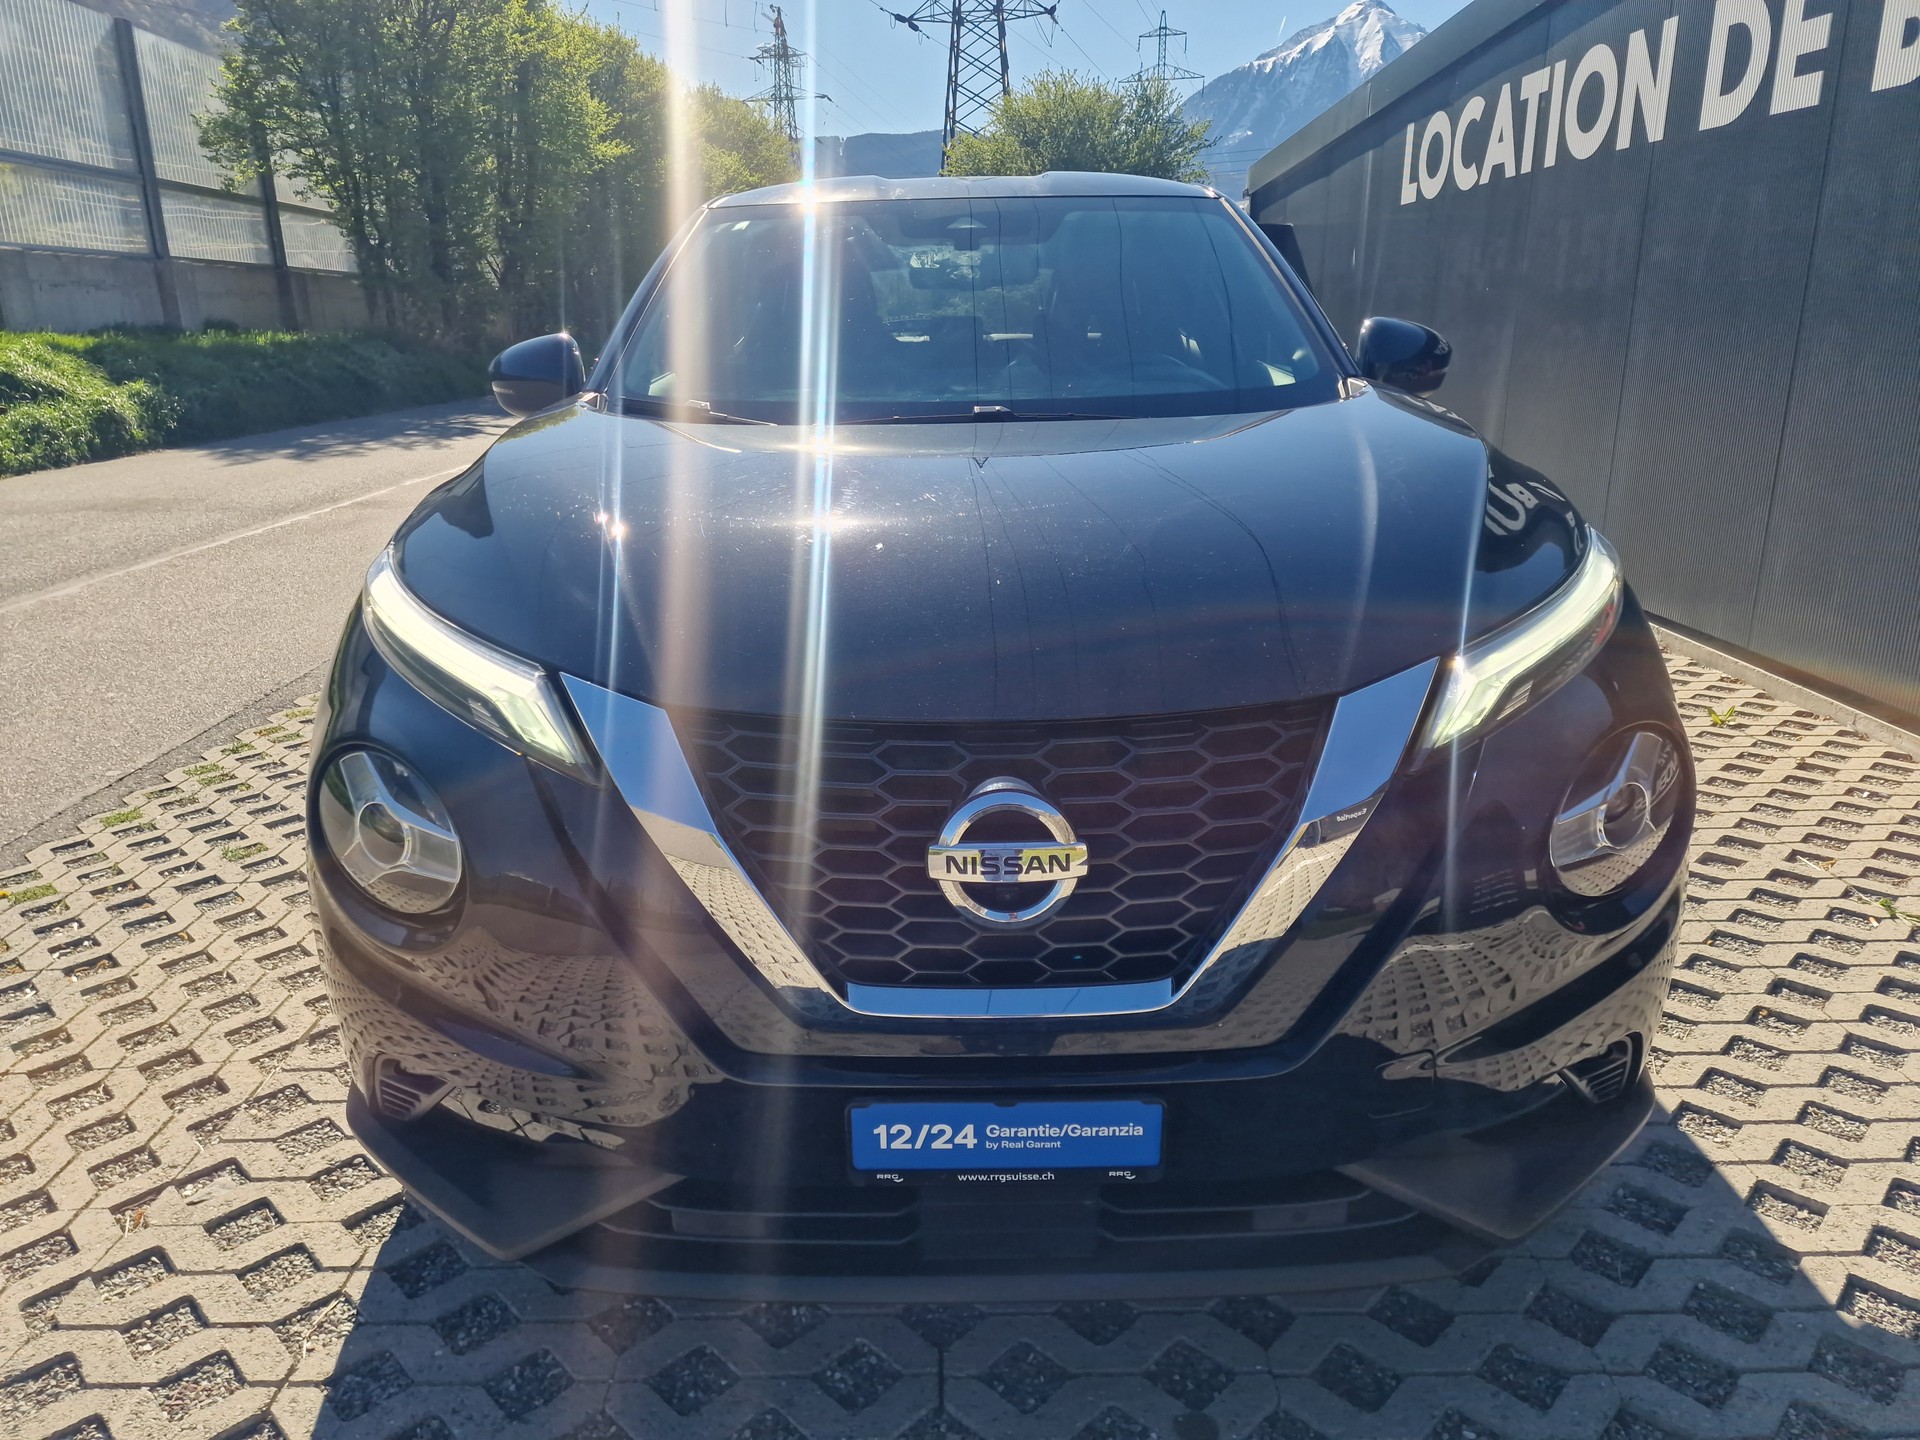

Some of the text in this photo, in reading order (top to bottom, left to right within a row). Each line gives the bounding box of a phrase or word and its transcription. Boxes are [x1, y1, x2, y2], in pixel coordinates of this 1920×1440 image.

[1400, 16, 1679, 205] LOCATION
[1699, 0, 1833, 131] DE
[945, 853, 1071, 875] NISSAN
[873, 1123, 978, 1150] 12/24
[985, 1122, 1144, 1138] Garantie/Garanzia
[985, 1140, 1062, 1150] by Real Garant
[957, 1171, 1056, 1183] www.rrgsuisse.ch
